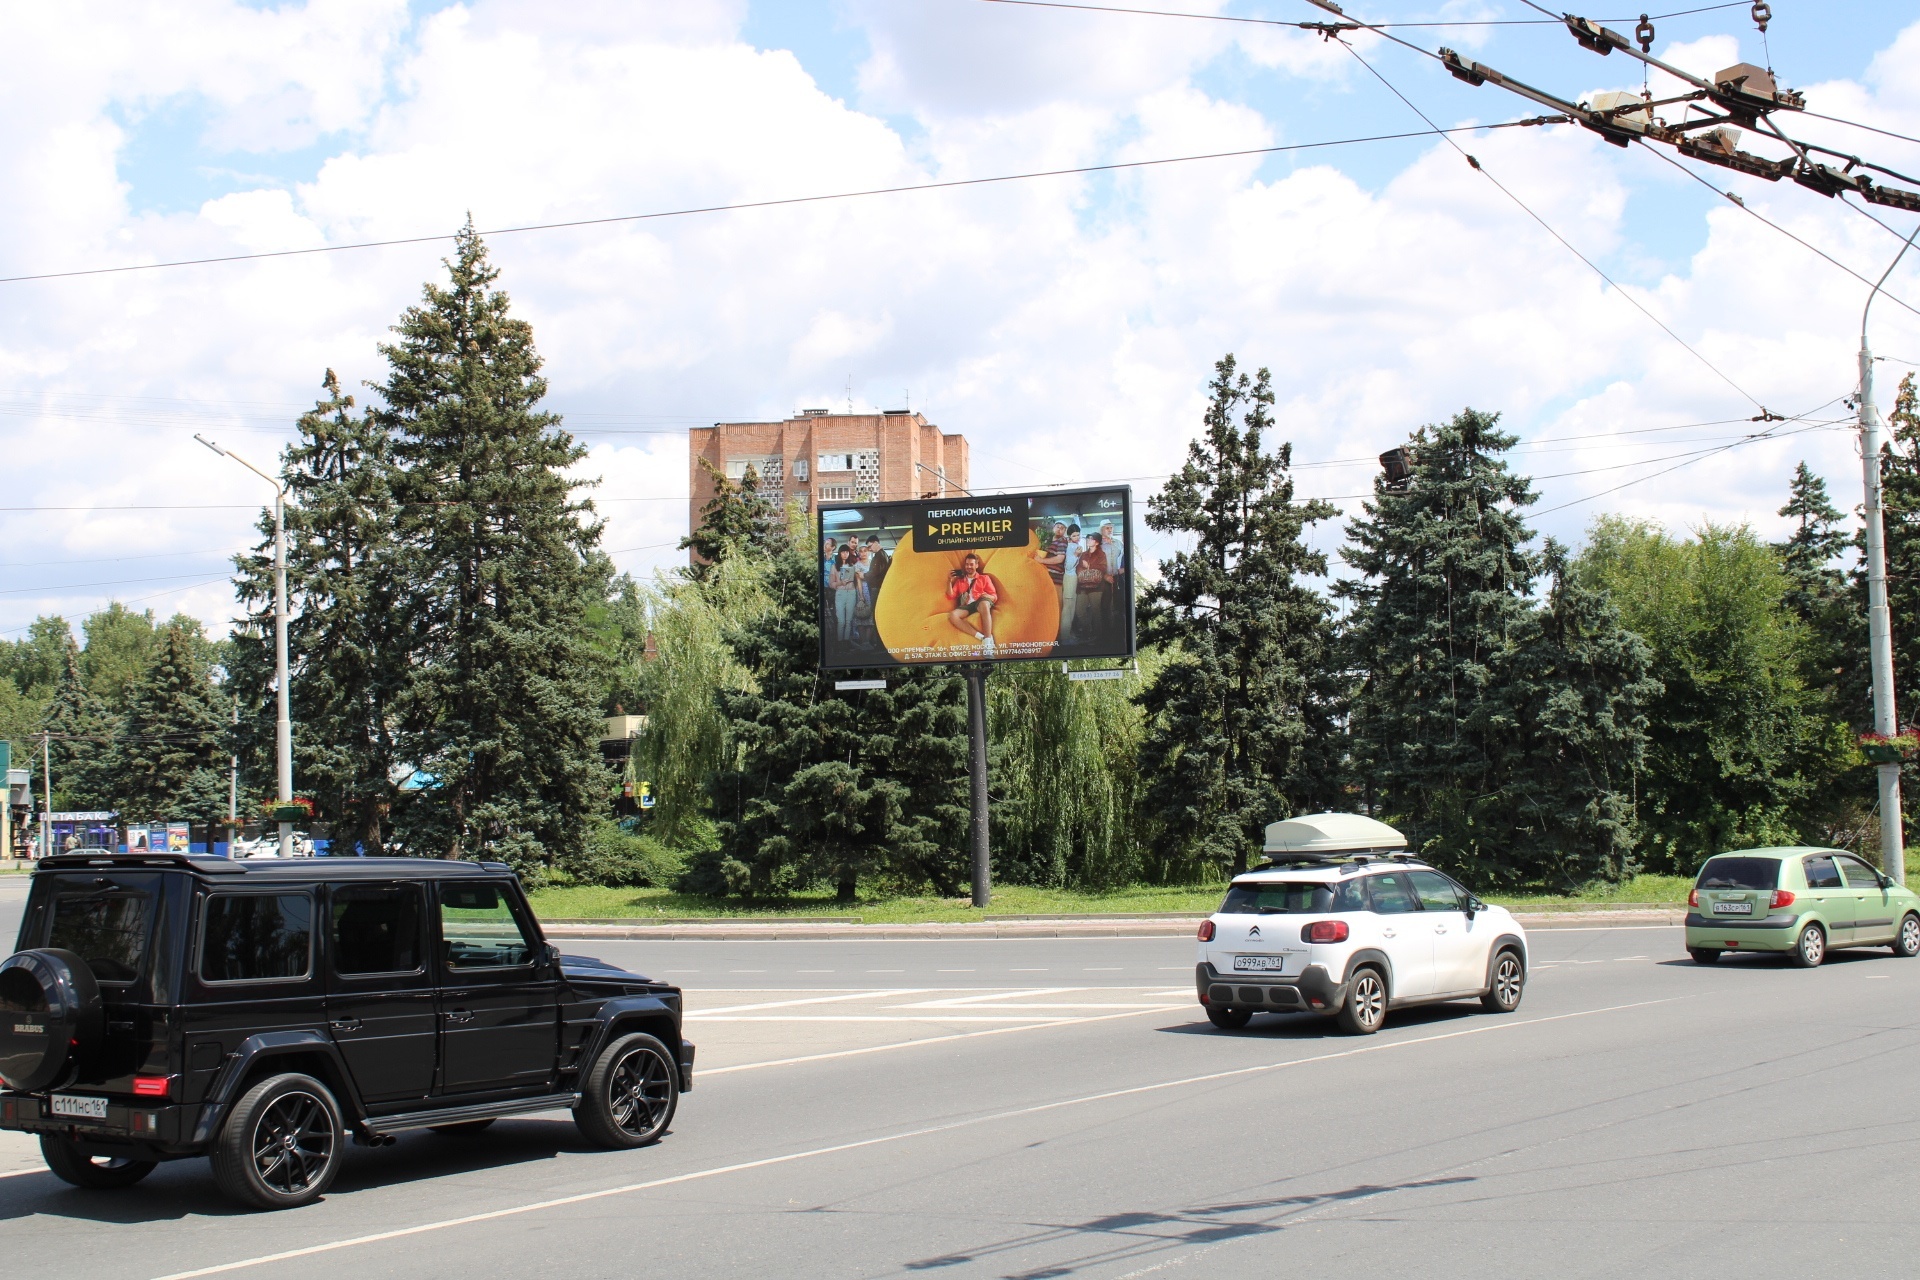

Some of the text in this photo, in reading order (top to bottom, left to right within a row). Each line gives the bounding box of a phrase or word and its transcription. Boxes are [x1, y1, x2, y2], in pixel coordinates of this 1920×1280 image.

[1099, 499, 1117, 509] 16+
[927, 505, 1012, 519] ПЕРЕКЛЮЧИСЬ НА
[941, 519, 1012, 536] PREMIER
[937, 535, 1004, 545] ОНЛАЙН-КИНОТЕАТР
[58, 812, 102, 821] ТАБАК
[14, 1025, 44, 1033] BRABUS
[55, 1098, 106, 1114] С111НС 161
